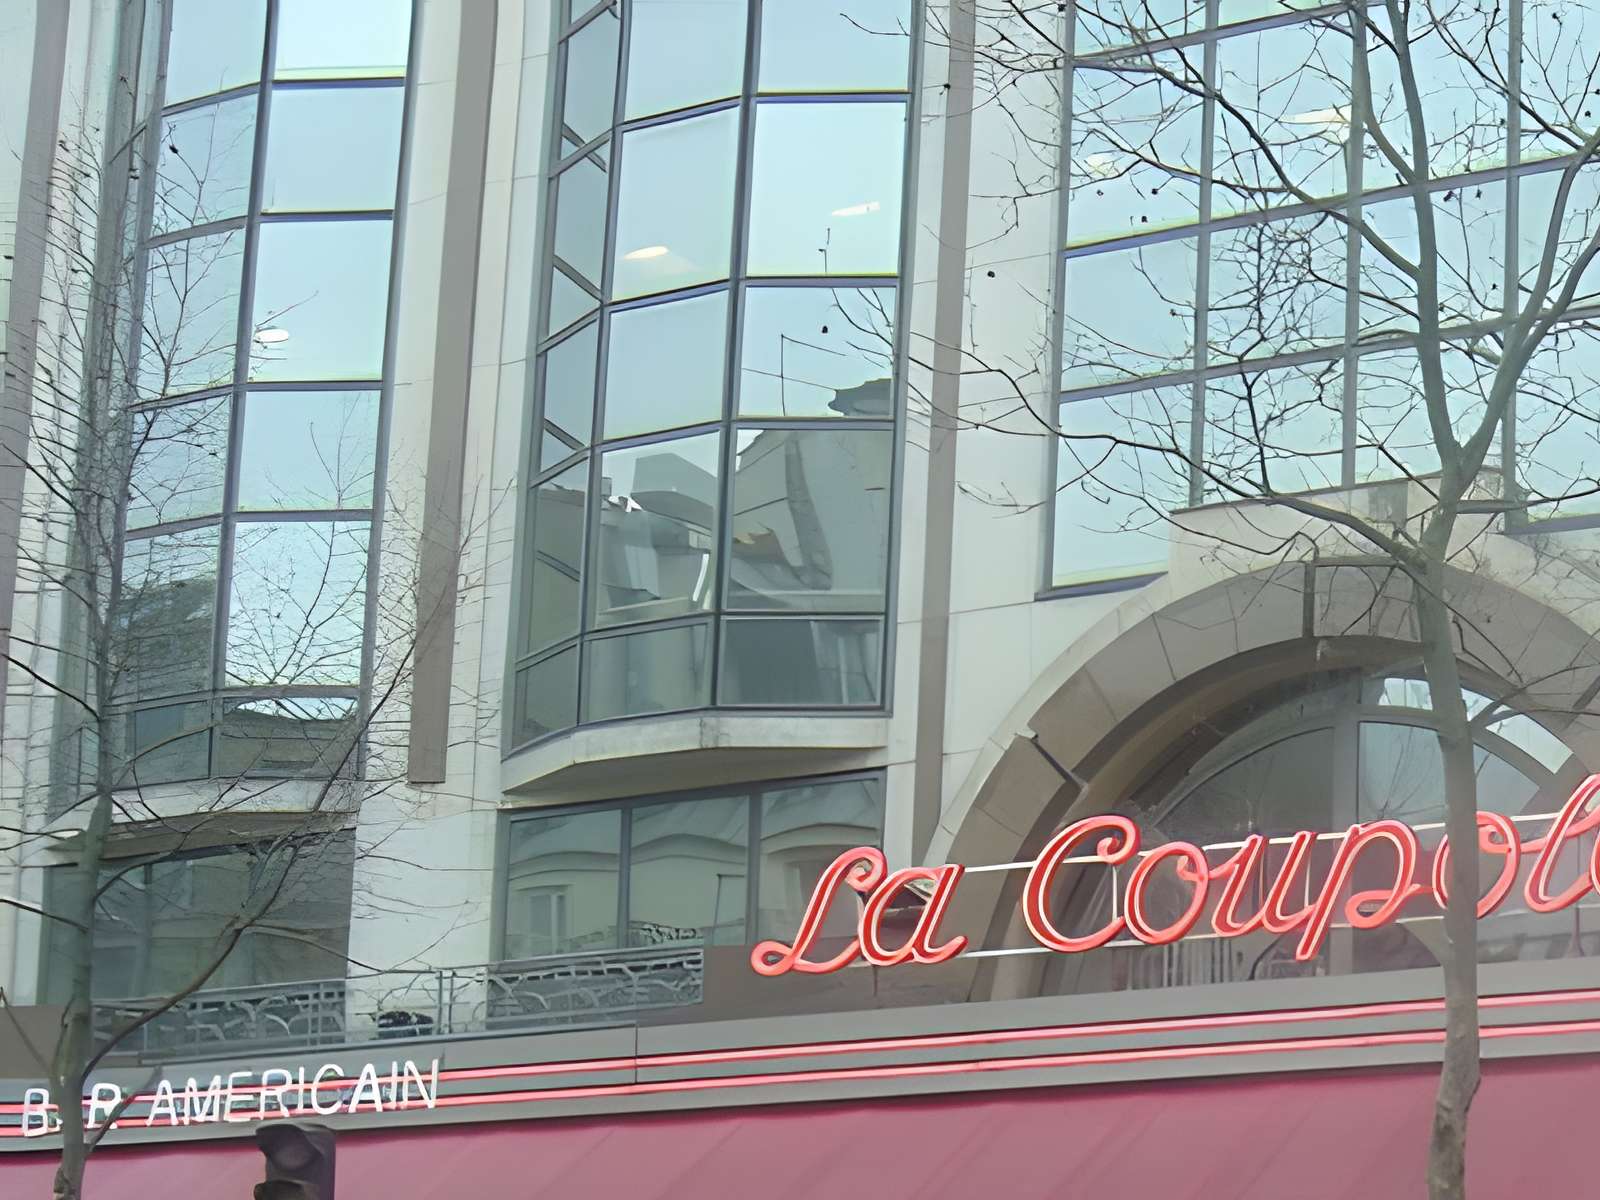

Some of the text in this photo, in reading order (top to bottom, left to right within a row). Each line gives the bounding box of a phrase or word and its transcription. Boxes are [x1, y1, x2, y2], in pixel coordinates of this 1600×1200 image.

[750, 845, 967, 977] La
[22, 1058, 440, 1137] BR AMERICAIN
